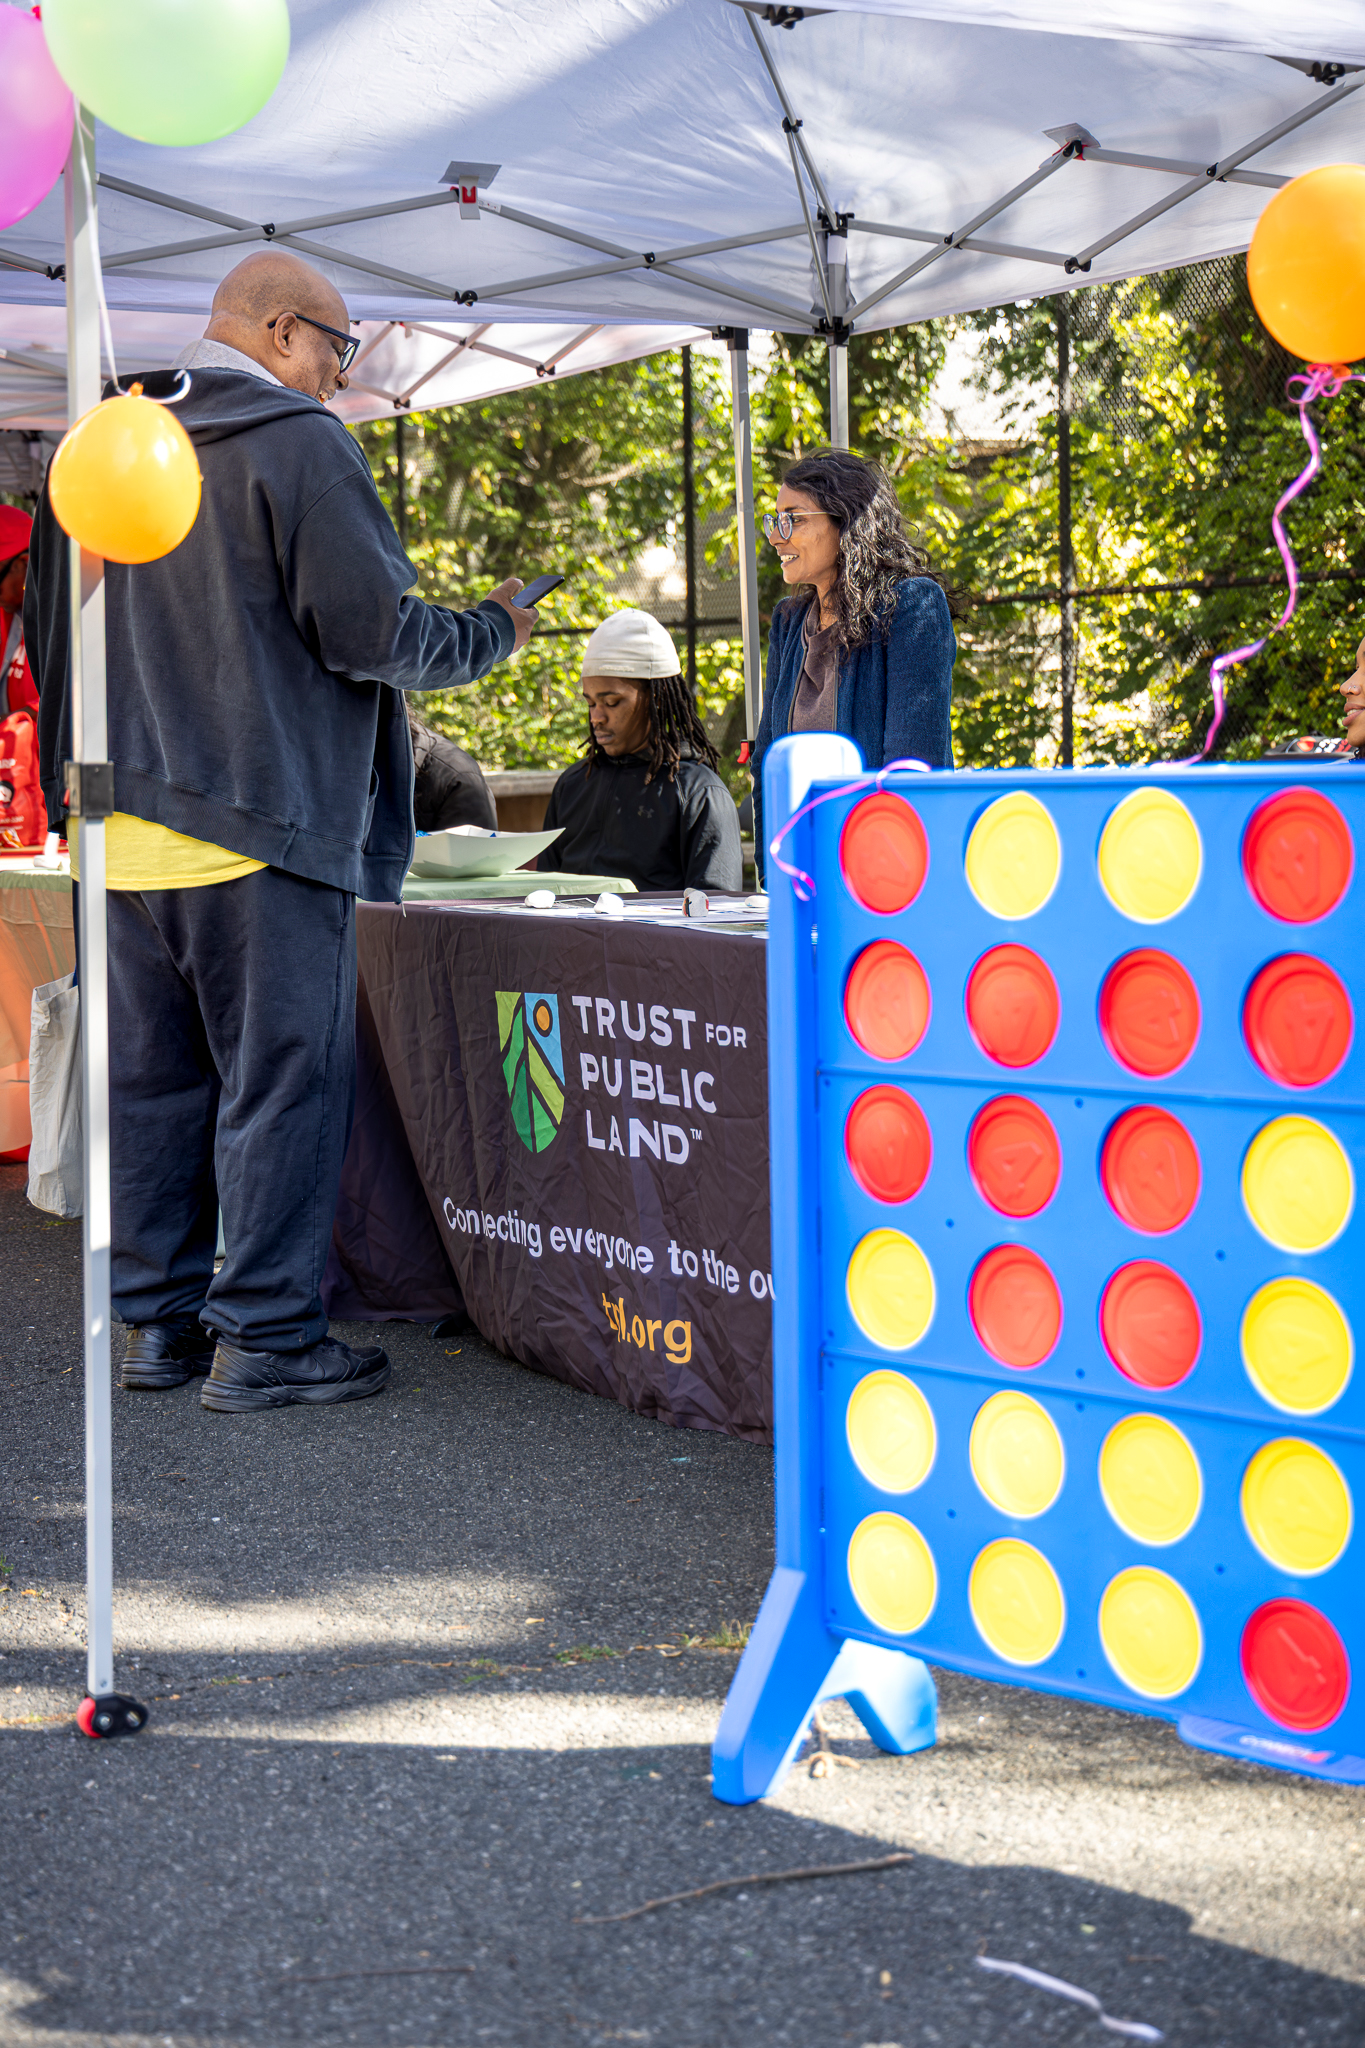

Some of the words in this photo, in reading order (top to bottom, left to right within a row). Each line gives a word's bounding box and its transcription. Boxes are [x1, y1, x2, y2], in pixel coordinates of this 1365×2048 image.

[572, 995, 696, 1049] TRUST
[705, 1022, 747, 1048] FOR
[579, 1052, 717, 1114] PUBLIC
[550, 1225, 654, 1274] everyone
[667, 1239, 698, 1277] to
[702, 1248, 739, 1293] the
